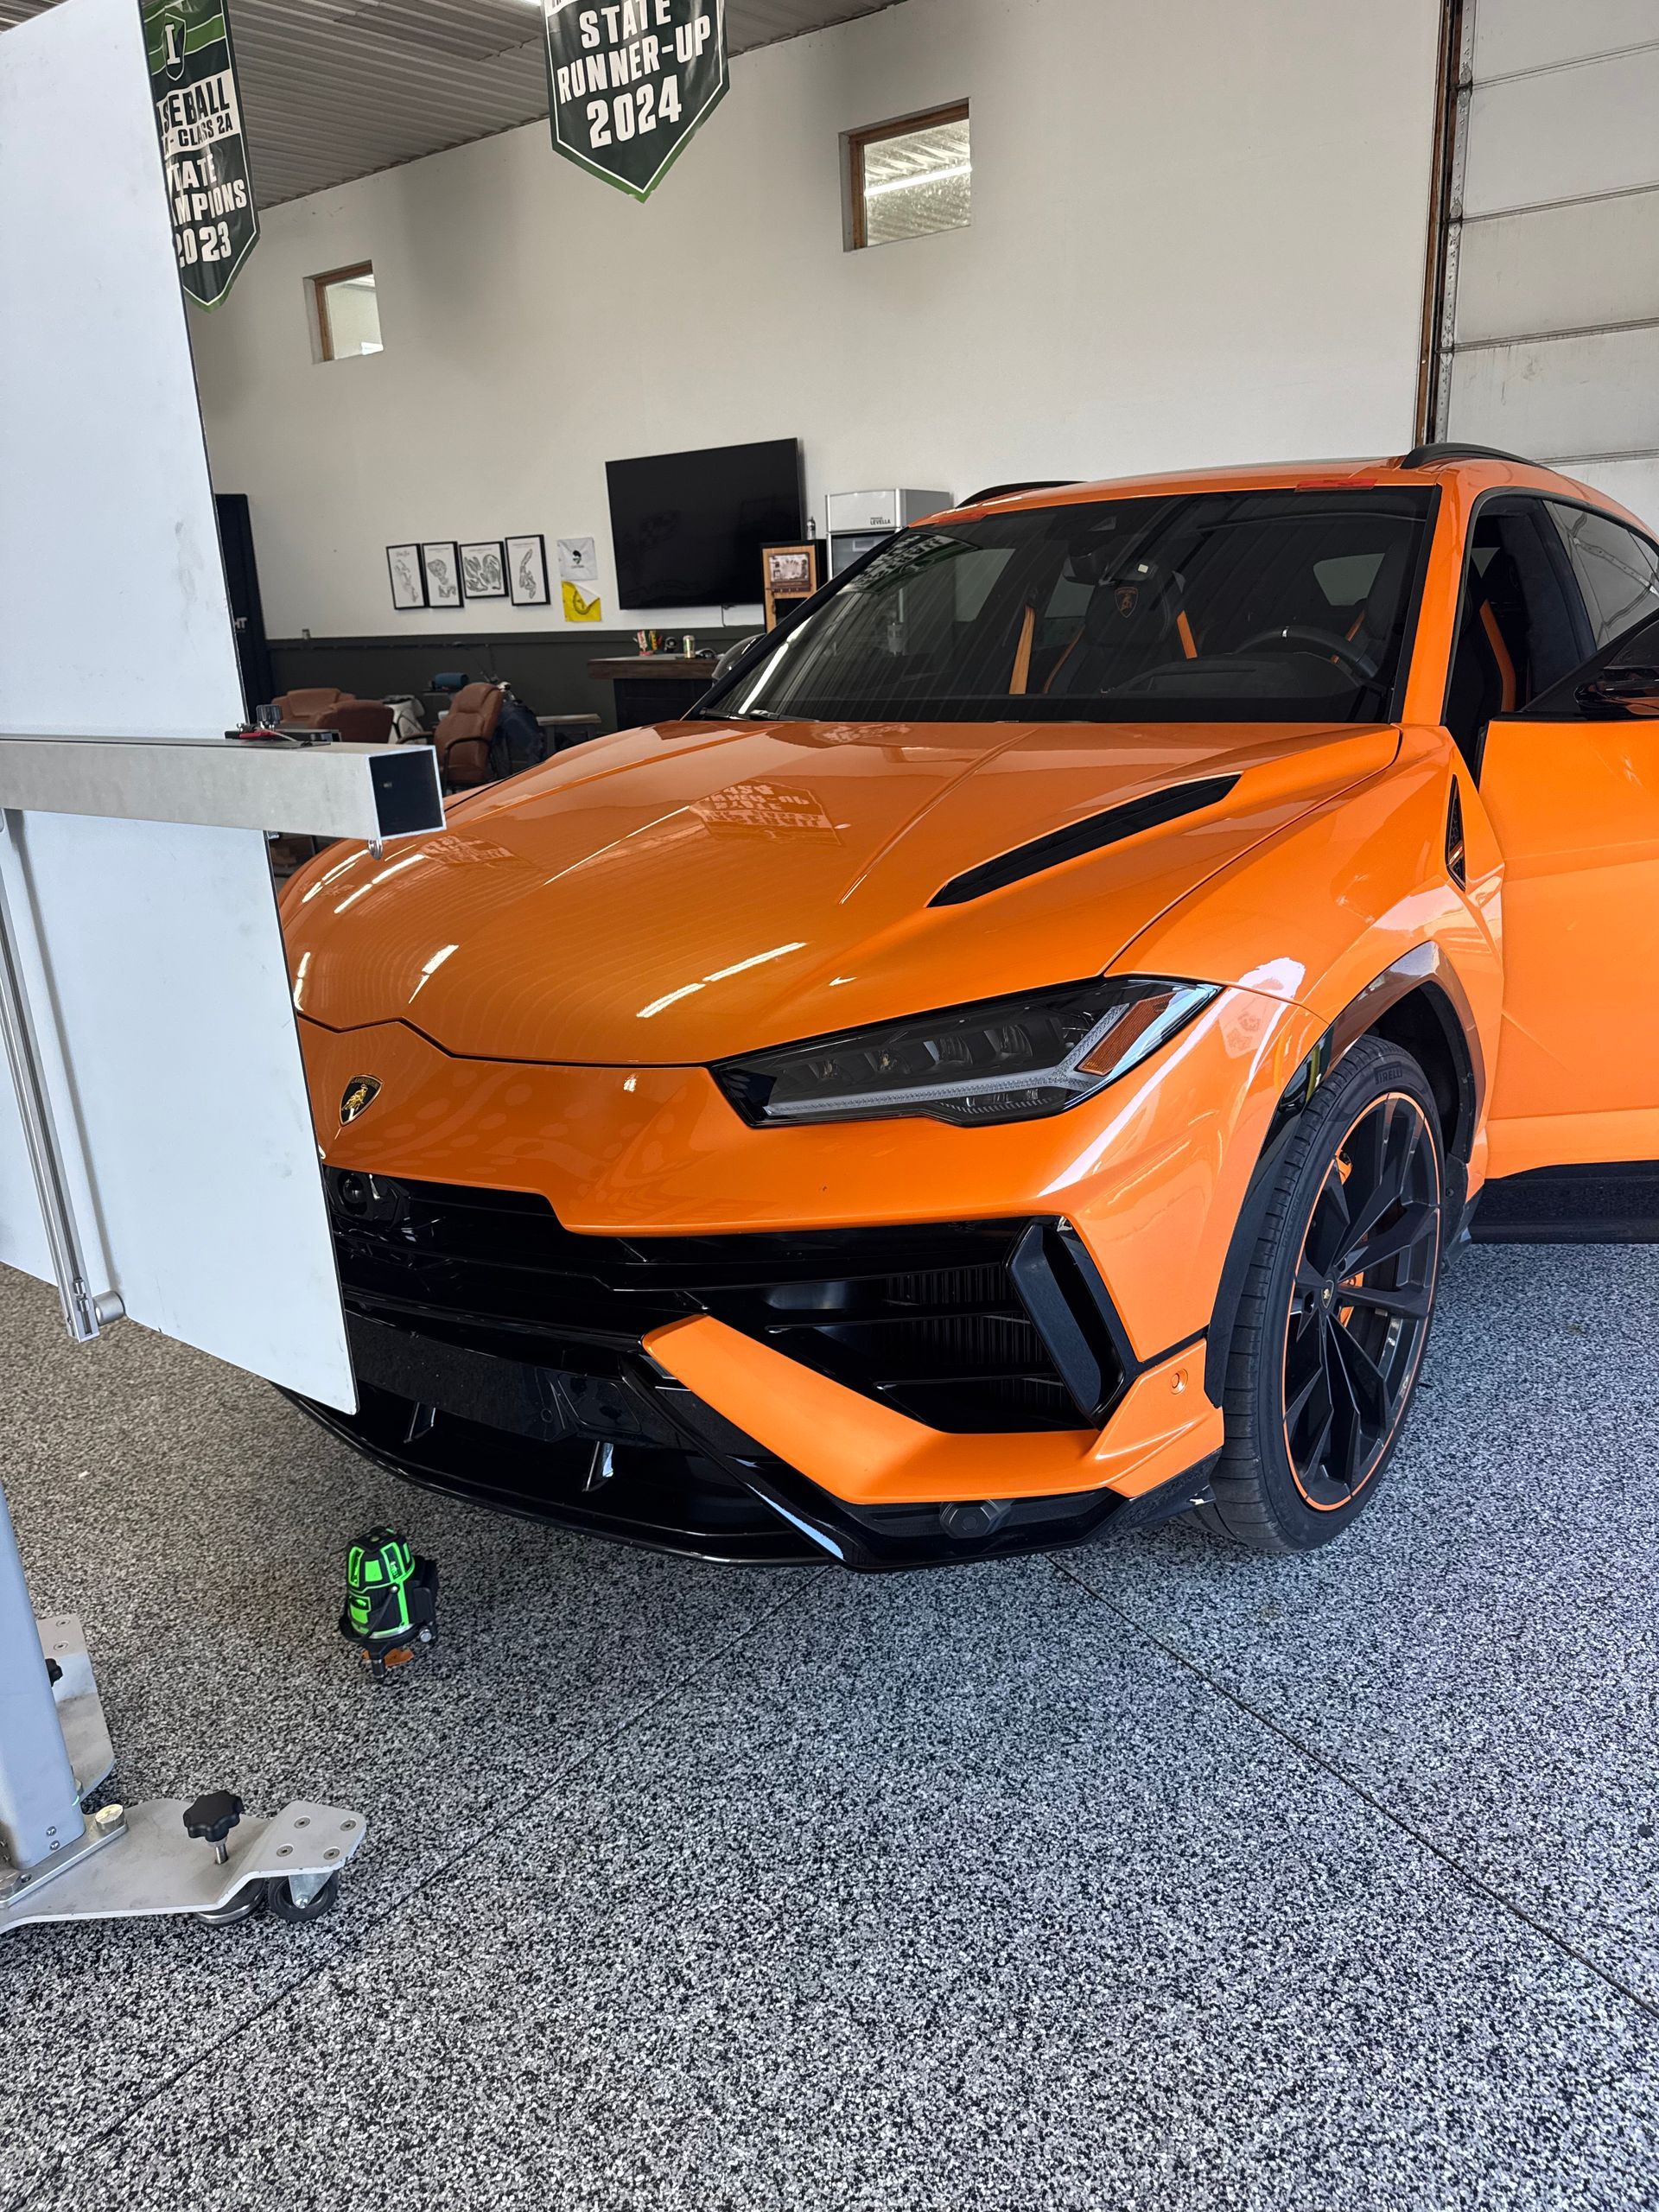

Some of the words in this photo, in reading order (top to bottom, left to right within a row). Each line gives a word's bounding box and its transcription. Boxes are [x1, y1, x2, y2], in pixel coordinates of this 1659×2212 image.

[579, 0, 671, 49] STATE
[556, 15, 711, 105] RUNNER-UP
[177, 119, 215, 147] CLASS
[216, 112, 233, 134] 2A
[586, 74, 683, 149] 2024
[171, 179, 247, 226] MPIONS
[1374, 1061, 1403, 1085] PIRELLI
